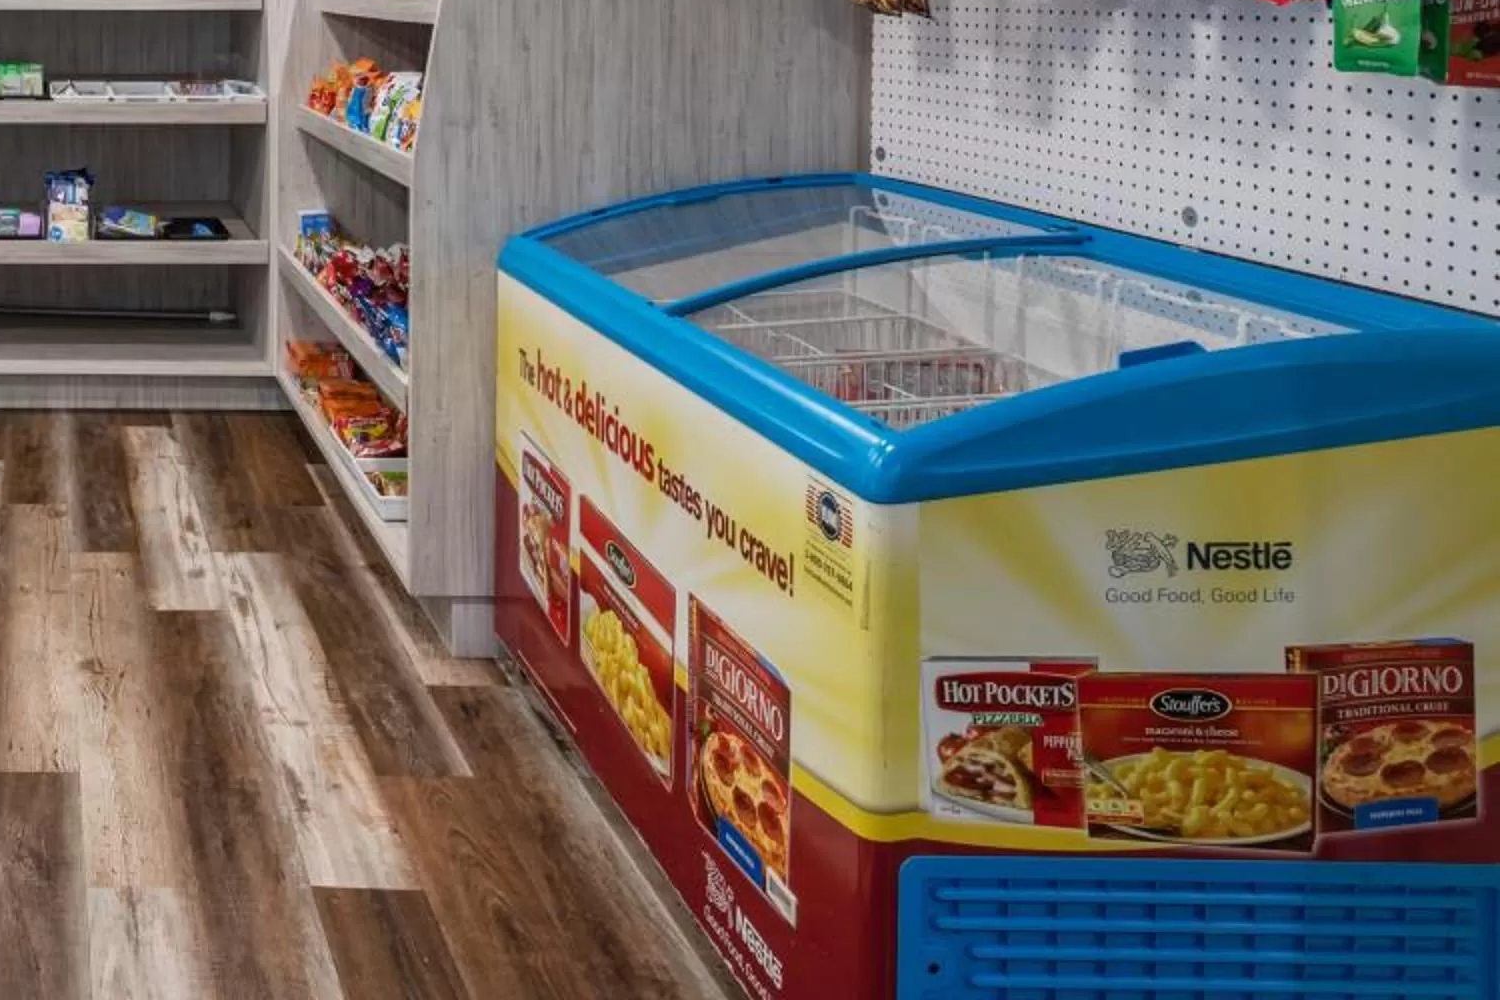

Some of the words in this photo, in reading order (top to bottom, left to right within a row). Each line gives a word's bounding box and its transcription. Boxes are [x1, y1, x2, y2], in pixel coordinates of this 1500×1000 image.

[518, 347, 535, 388] The
[536, 347, 562, 409] hot
[563, 376, 574, 419] &
[575, 380, 655, 483] delicious
[657, 457, 703, 521] tastes
[704, 499, 736, 550] you
[739, 527, 795, 598] crave!
[1105, 587, 1153, 604] Good
[1157, 587, 1205, 606] Food,
[1211, 587, 1258, 604] Good
[1263, 587, 1296, 604] Life
[942, 680, 983, 704] HOT
[984, 681, 1076, 708] POCKETS
[1159, 694, 1222, 716] Stouffer's
[1338, 704, 1414, 720] TRADITIONAL
[1415, 701, 1448, 713] CRUST
